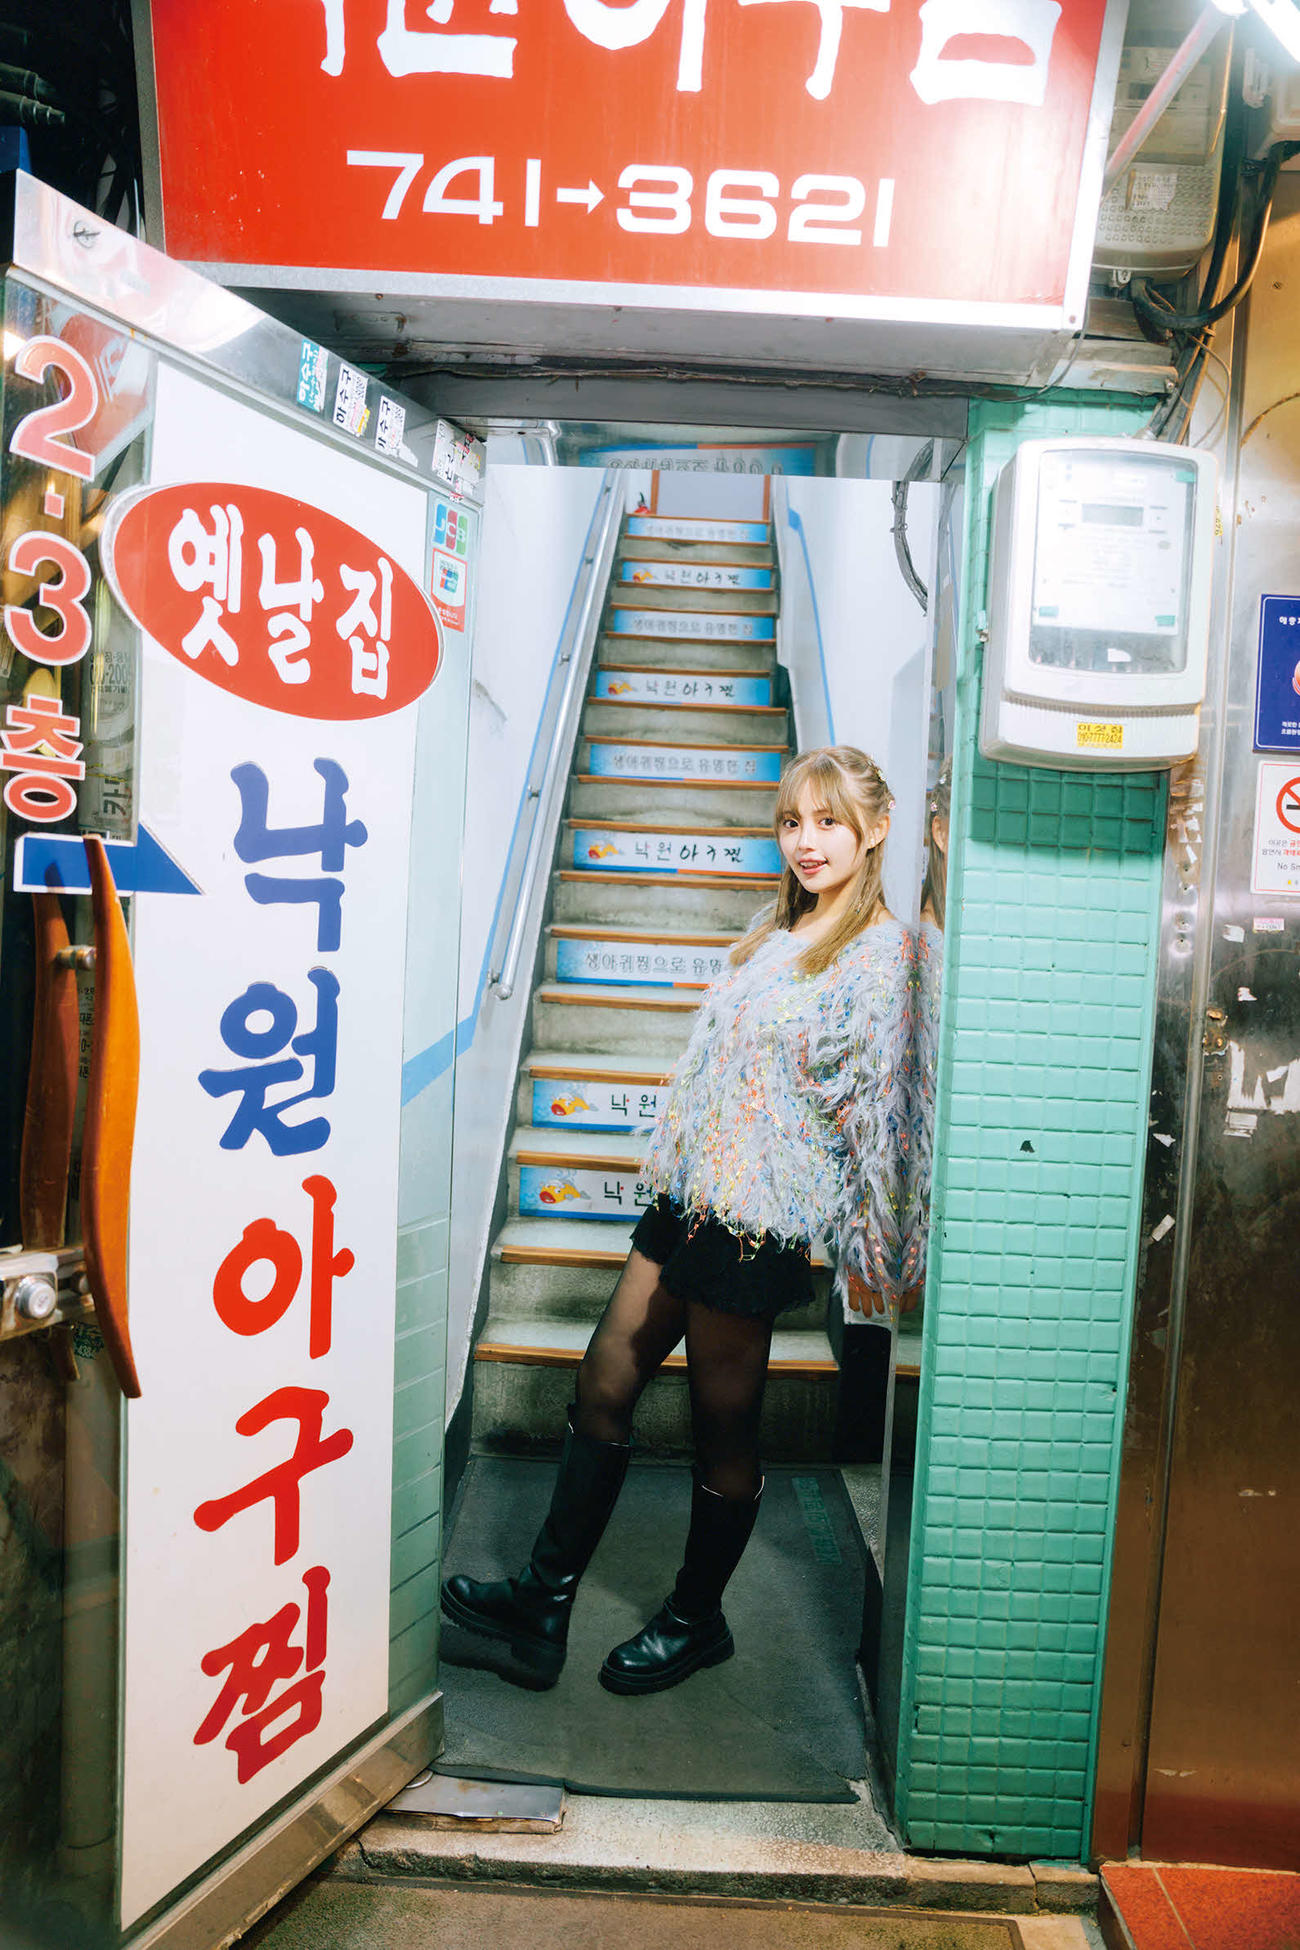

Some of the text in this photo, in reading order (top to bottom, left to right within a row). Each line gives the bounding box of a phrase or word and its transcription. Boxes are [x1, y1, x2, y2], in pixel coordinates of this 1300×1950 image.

[346, 150, 895, 248] 741 3621
[336, 369, 351, 424] 하수구
[168, 503, 393, 700] 옛날집
